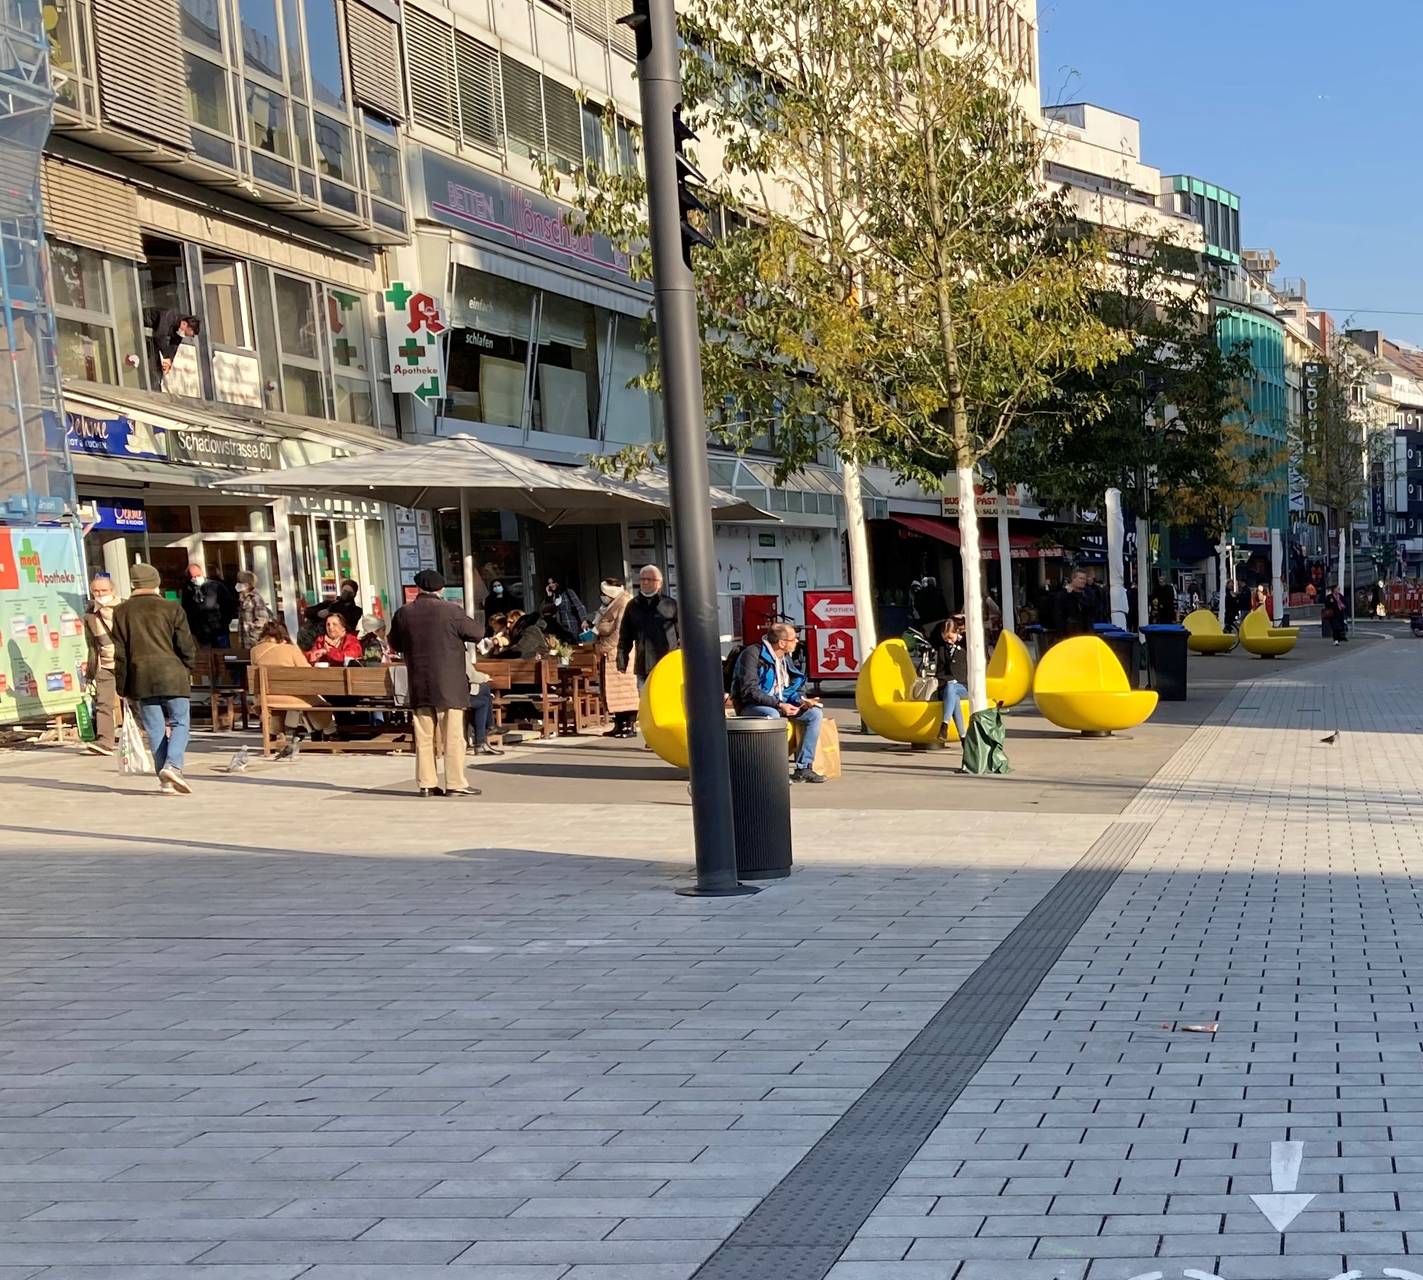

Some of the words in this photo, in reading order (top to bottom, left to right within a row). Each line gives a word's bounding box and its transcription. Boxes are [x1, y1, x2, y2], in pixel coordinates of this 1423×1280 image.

[447, 181, 496, 223] BETTEN
[465, 332, 495, 350] schlafen
[393, 364, 439, 375] Apotheke
[177, 431, 258, 457] Schadowstrasse
[259, 442, 273, 461] 80
[20, 551, 41, 567] medi
[36, 572, 75, 588] Apotheke
